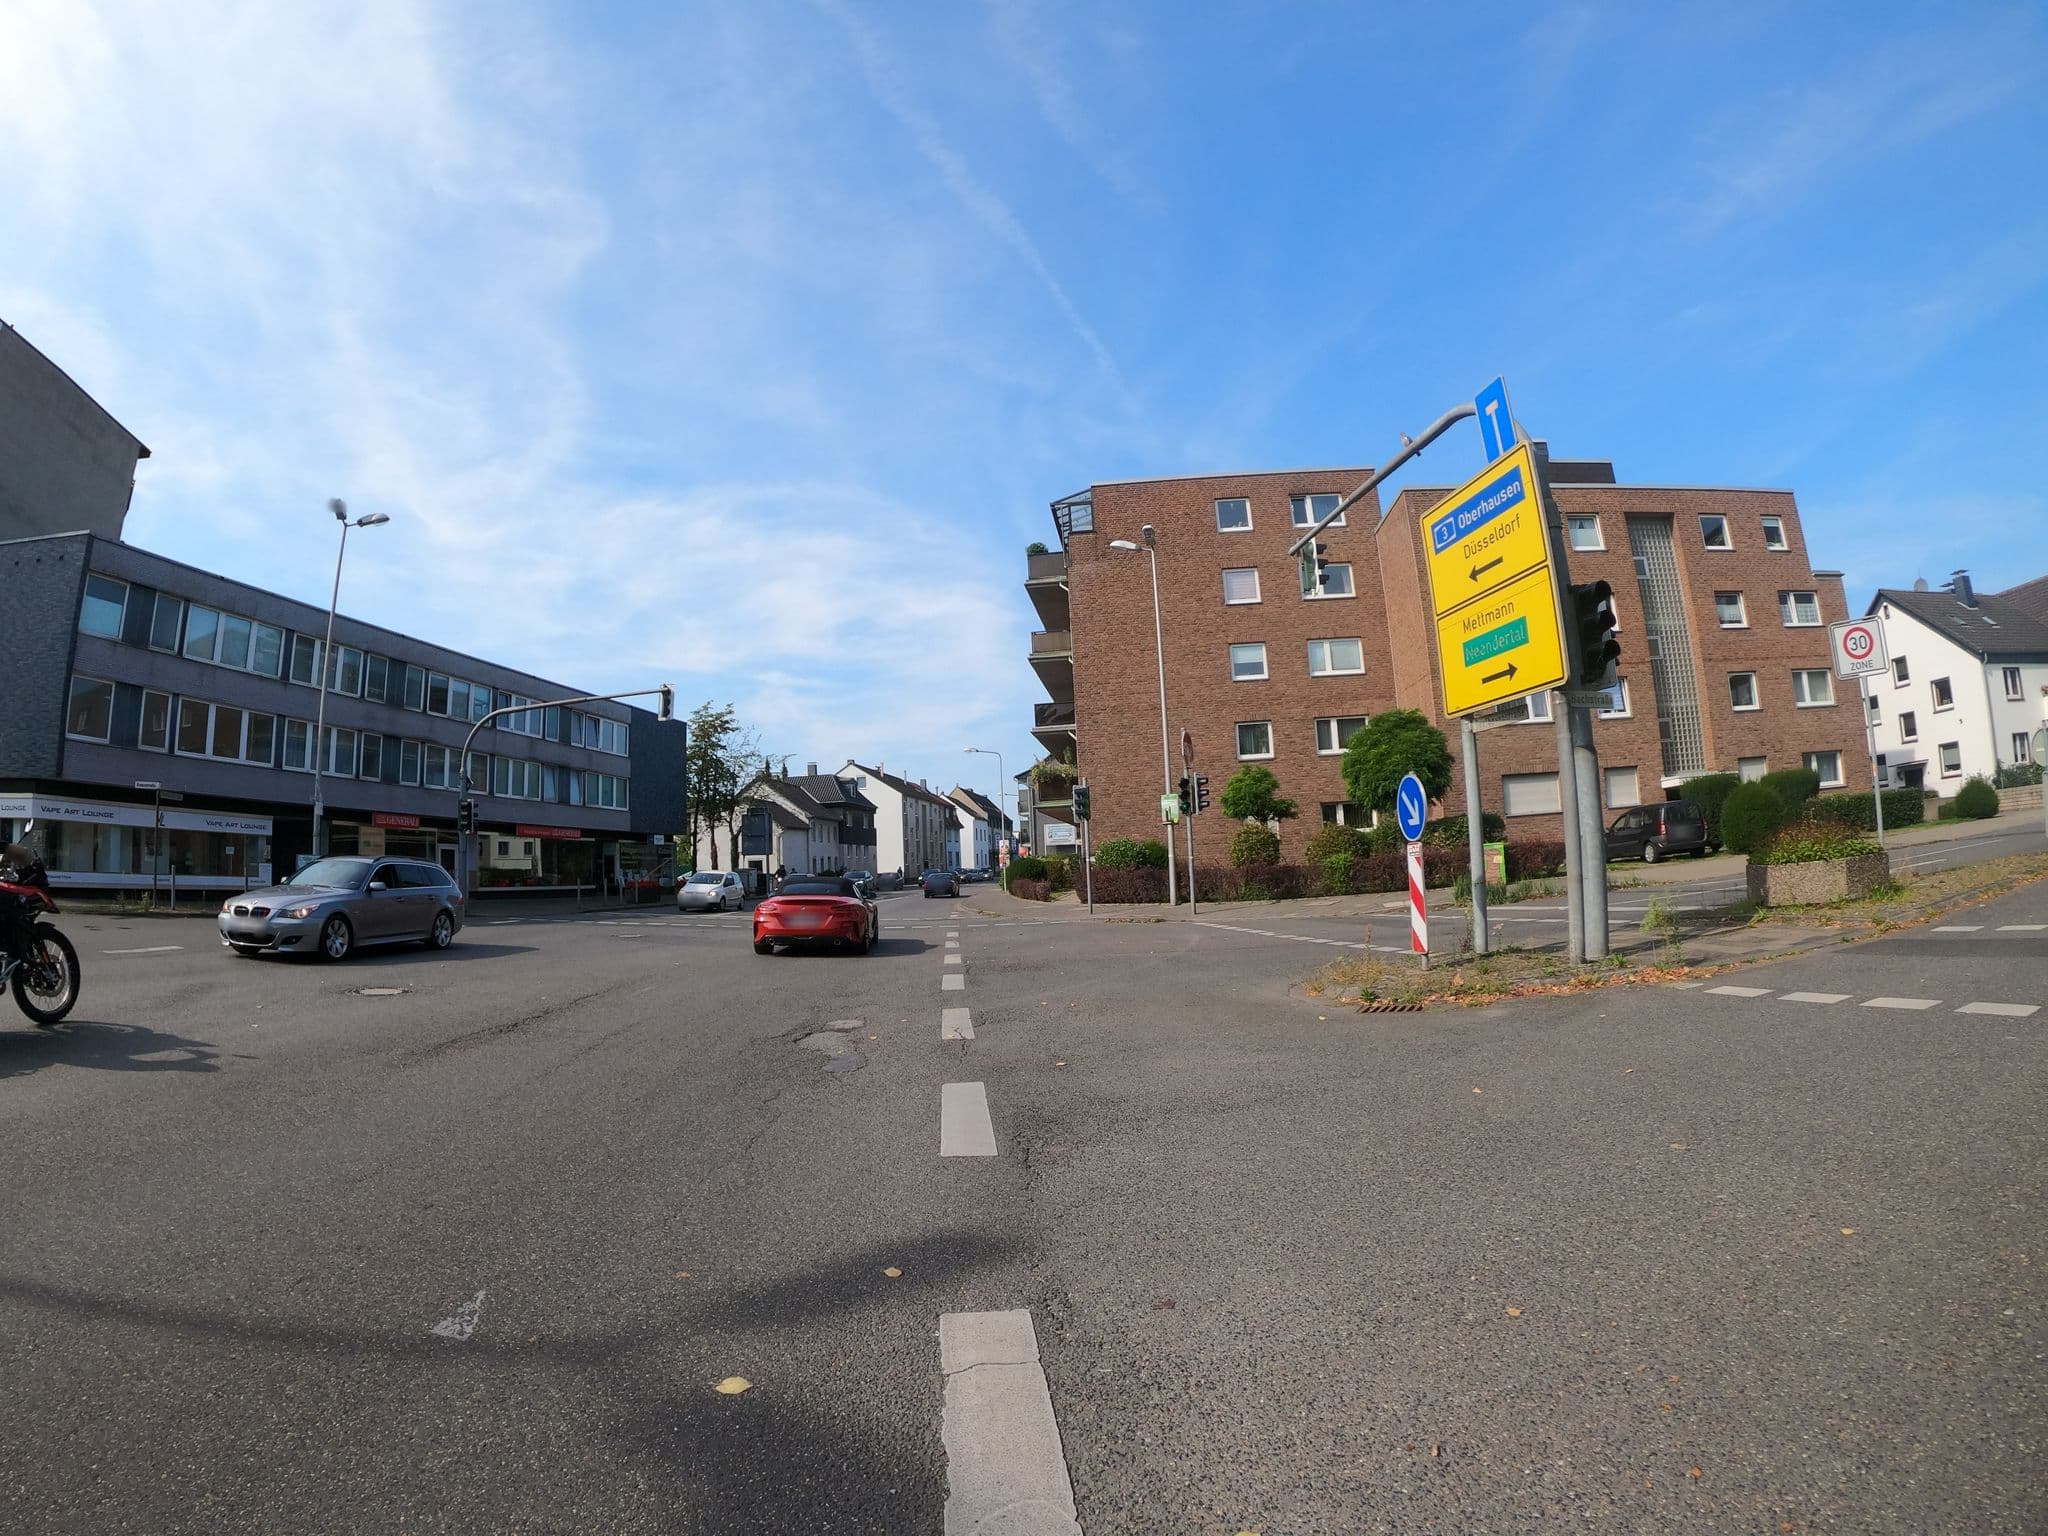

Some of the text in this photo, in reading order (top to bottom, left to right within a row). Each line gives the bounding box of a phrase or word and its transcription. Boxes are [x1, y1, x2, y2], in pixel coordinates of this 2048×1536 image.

[1441, 480, 1521, 540] 3 Oberhausen
[1463, 513, 1520, 560] Düsseldorf
[1462, 601, 1515, 634] Mettmann
[1465, 624, 1526, 661] Neandertal
[1849, 635, 1867, 651] 30
[1850, 660, 1874, 671] ZONE
[41, 805, 61, 814] VAPE
[82, 809, 114, 819] LOUNGE
[206, 819, 223, 827] VAPE
[240, 822, 267, 830] LOUNGE
